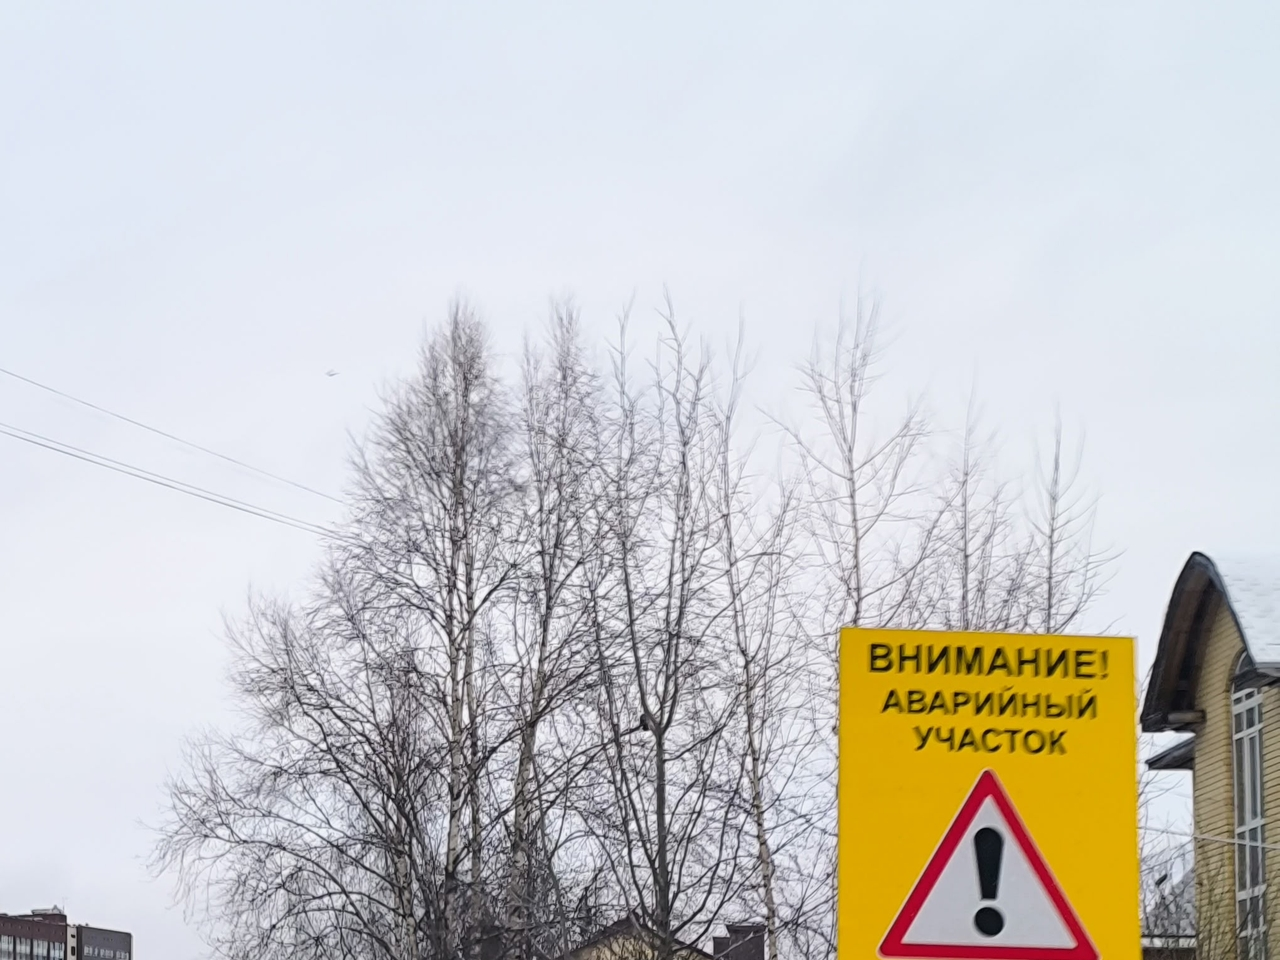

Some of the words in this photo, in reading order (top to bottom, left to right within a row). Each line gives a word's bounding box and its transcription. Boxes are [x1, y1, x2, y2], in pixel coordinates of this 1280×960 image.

[868, 643, 1109, 680] ВНИМАНИЕ!
[881, 685, 1098, 720] АВАРИЙНЫЙ
[913, 725, 1068, 756] УЧАСТОК
